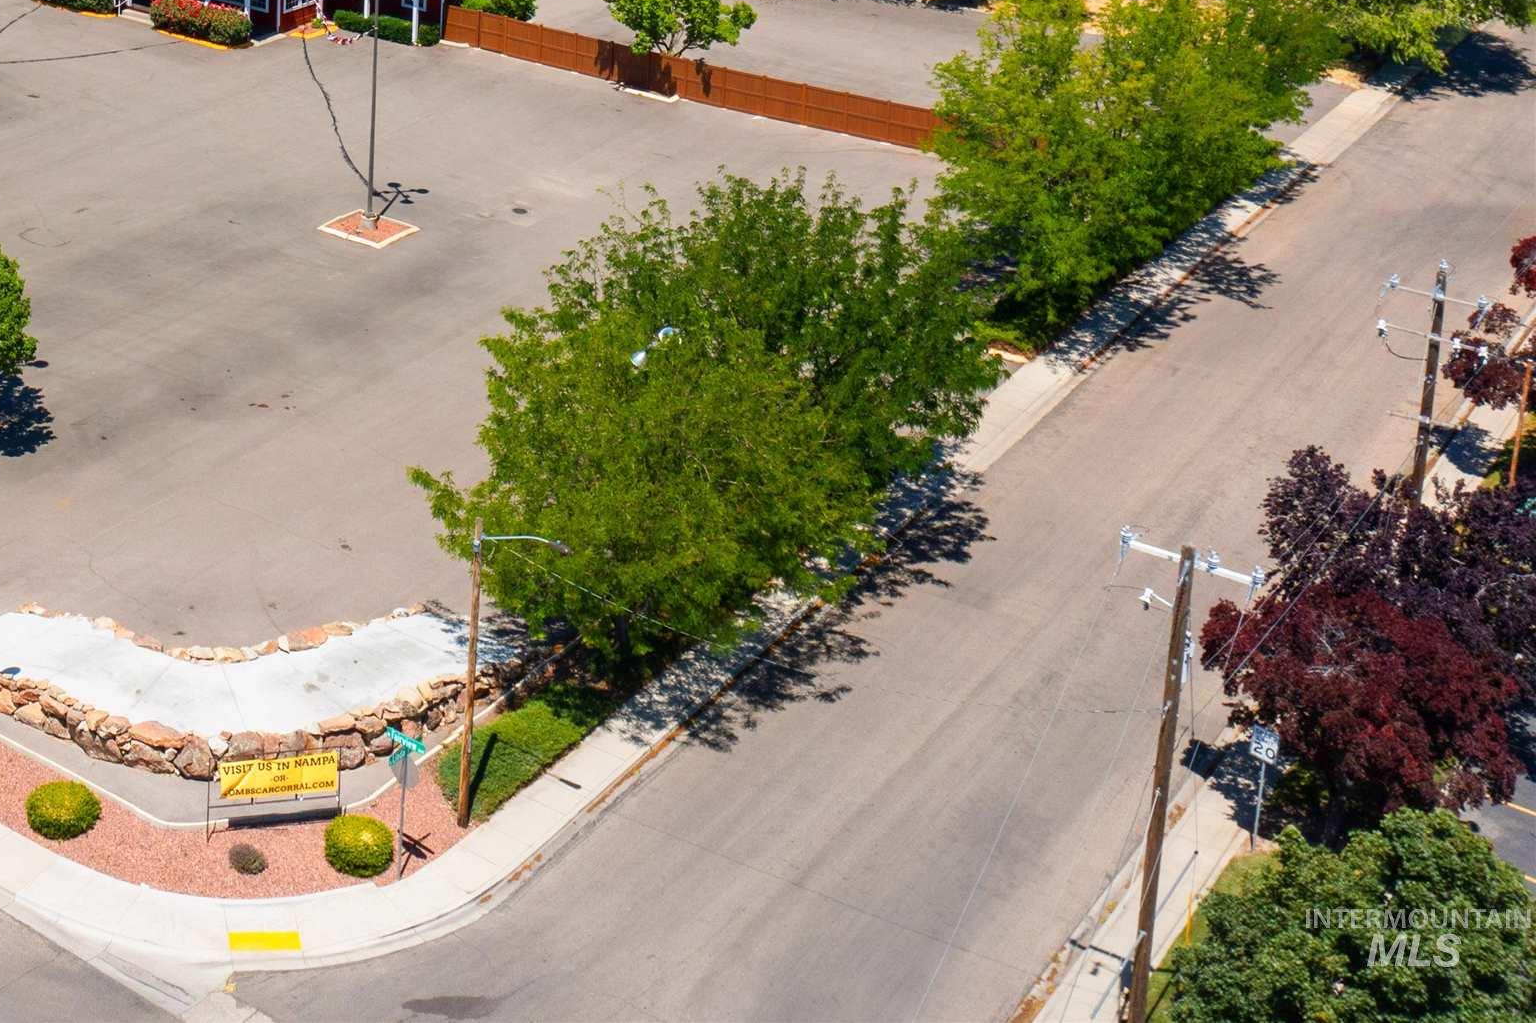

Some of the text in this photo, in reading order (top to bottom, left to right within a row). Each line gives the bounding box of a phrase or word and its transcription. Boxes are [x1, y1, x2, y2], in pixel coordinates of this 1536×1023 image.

[1254, 739, 1275, 759] 20
[222, 755, 336, 776] VISIT US IN NAMPA
[225, 780, 334, 796] OMBSCARCORRAL.COM
